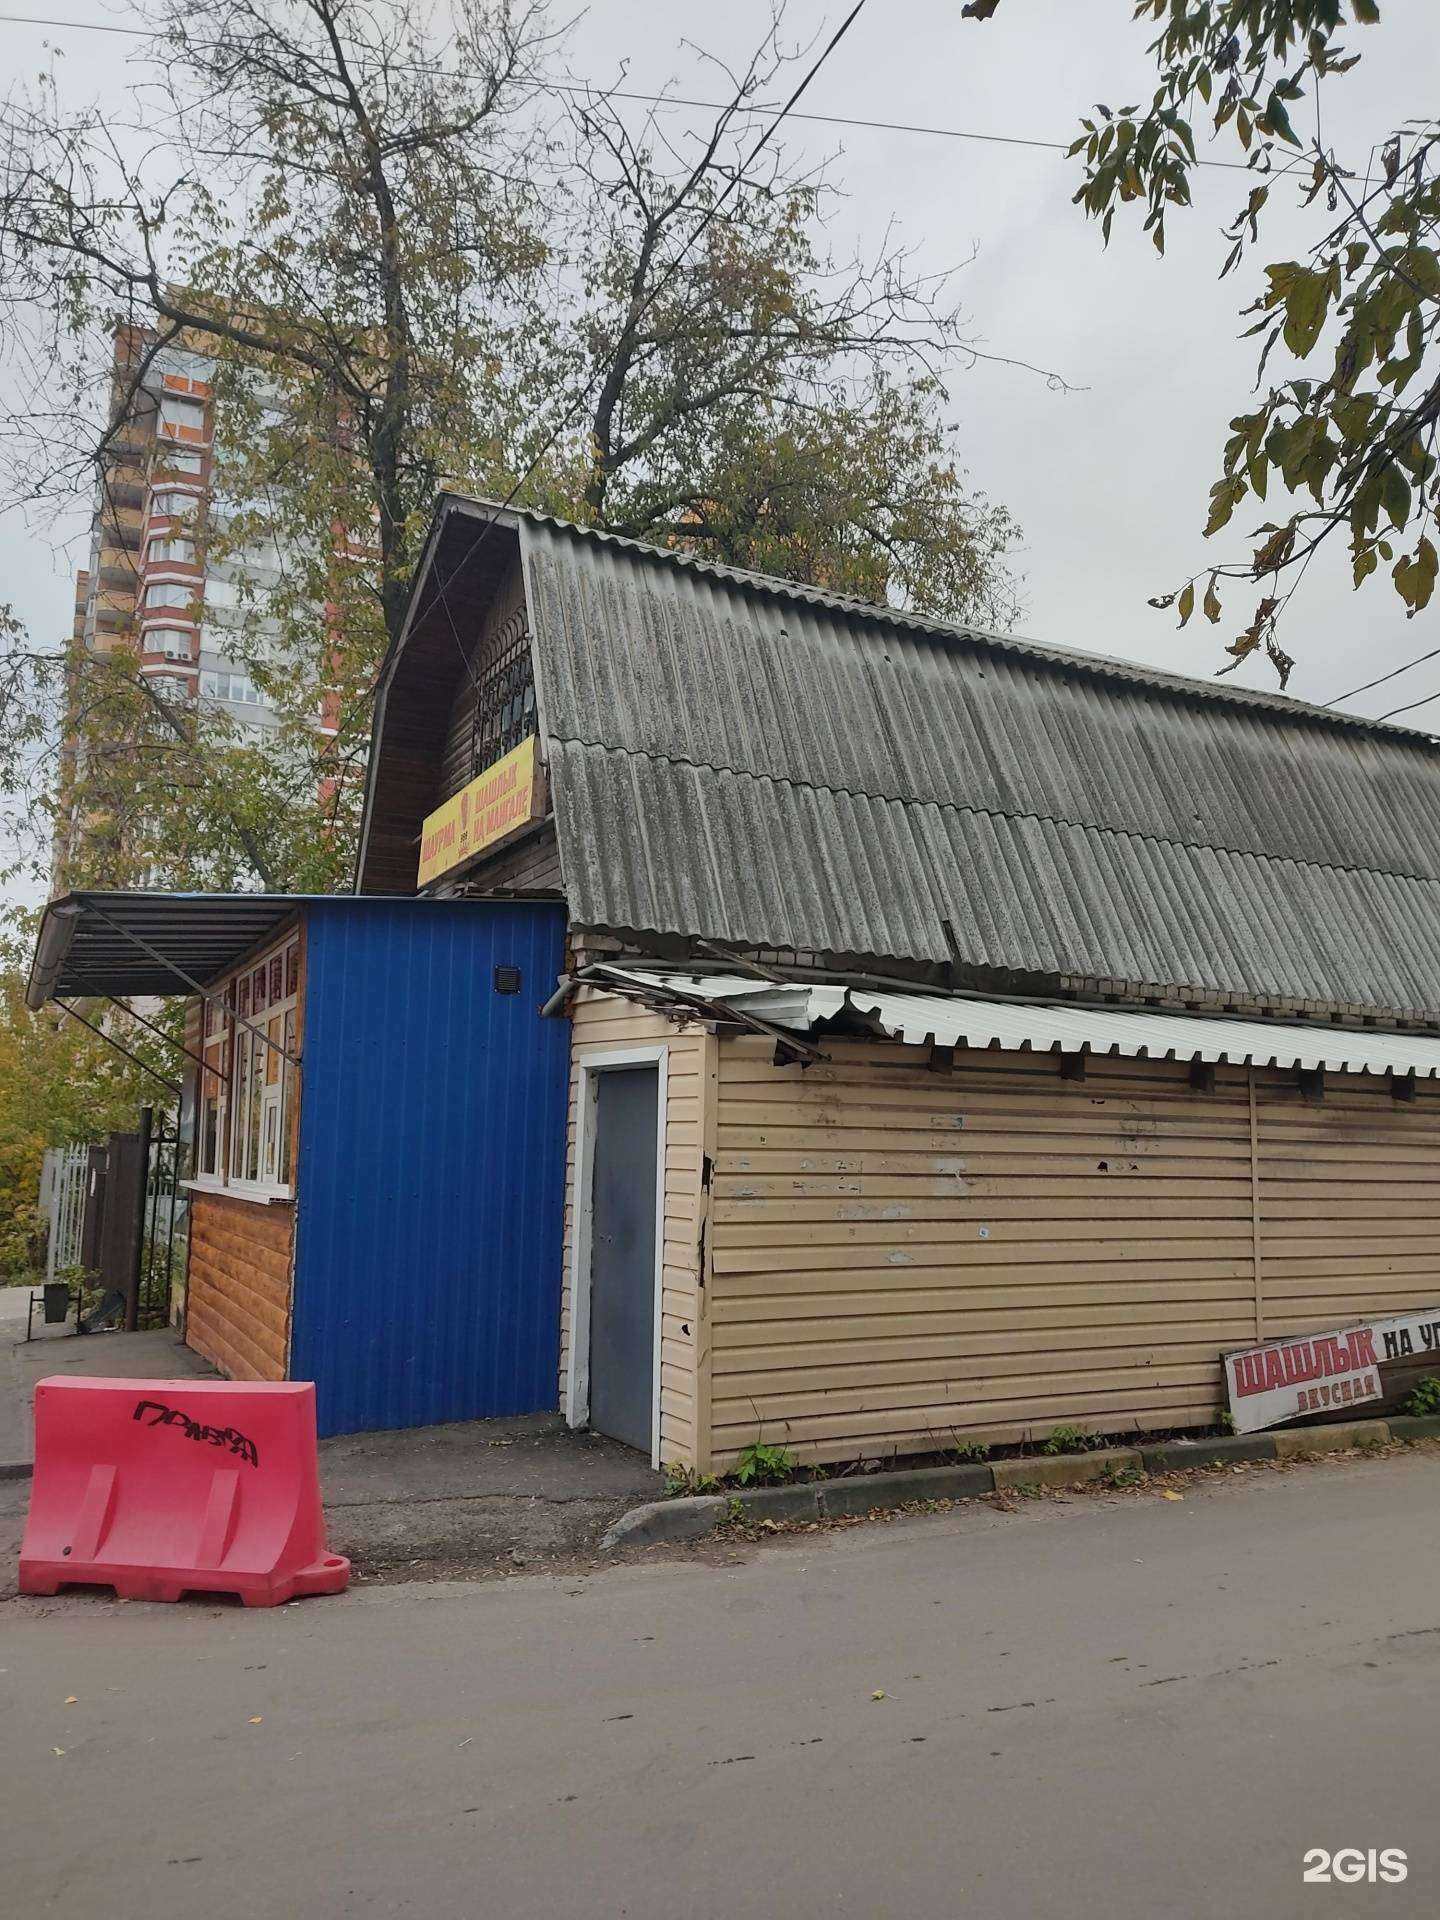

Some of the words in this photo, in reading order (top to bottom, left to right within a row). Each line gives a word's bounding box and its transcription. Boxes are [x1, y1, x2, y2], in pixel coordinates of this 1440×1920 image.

[422, 819, 456, 863] ШАУРМА
[1233, 1328, 1378, 1398] ШАШЛЫК
[1382, 1328, 1414, 1359] НА
[1297, 1374, 1376, 1411] ВКУСНАЯ
